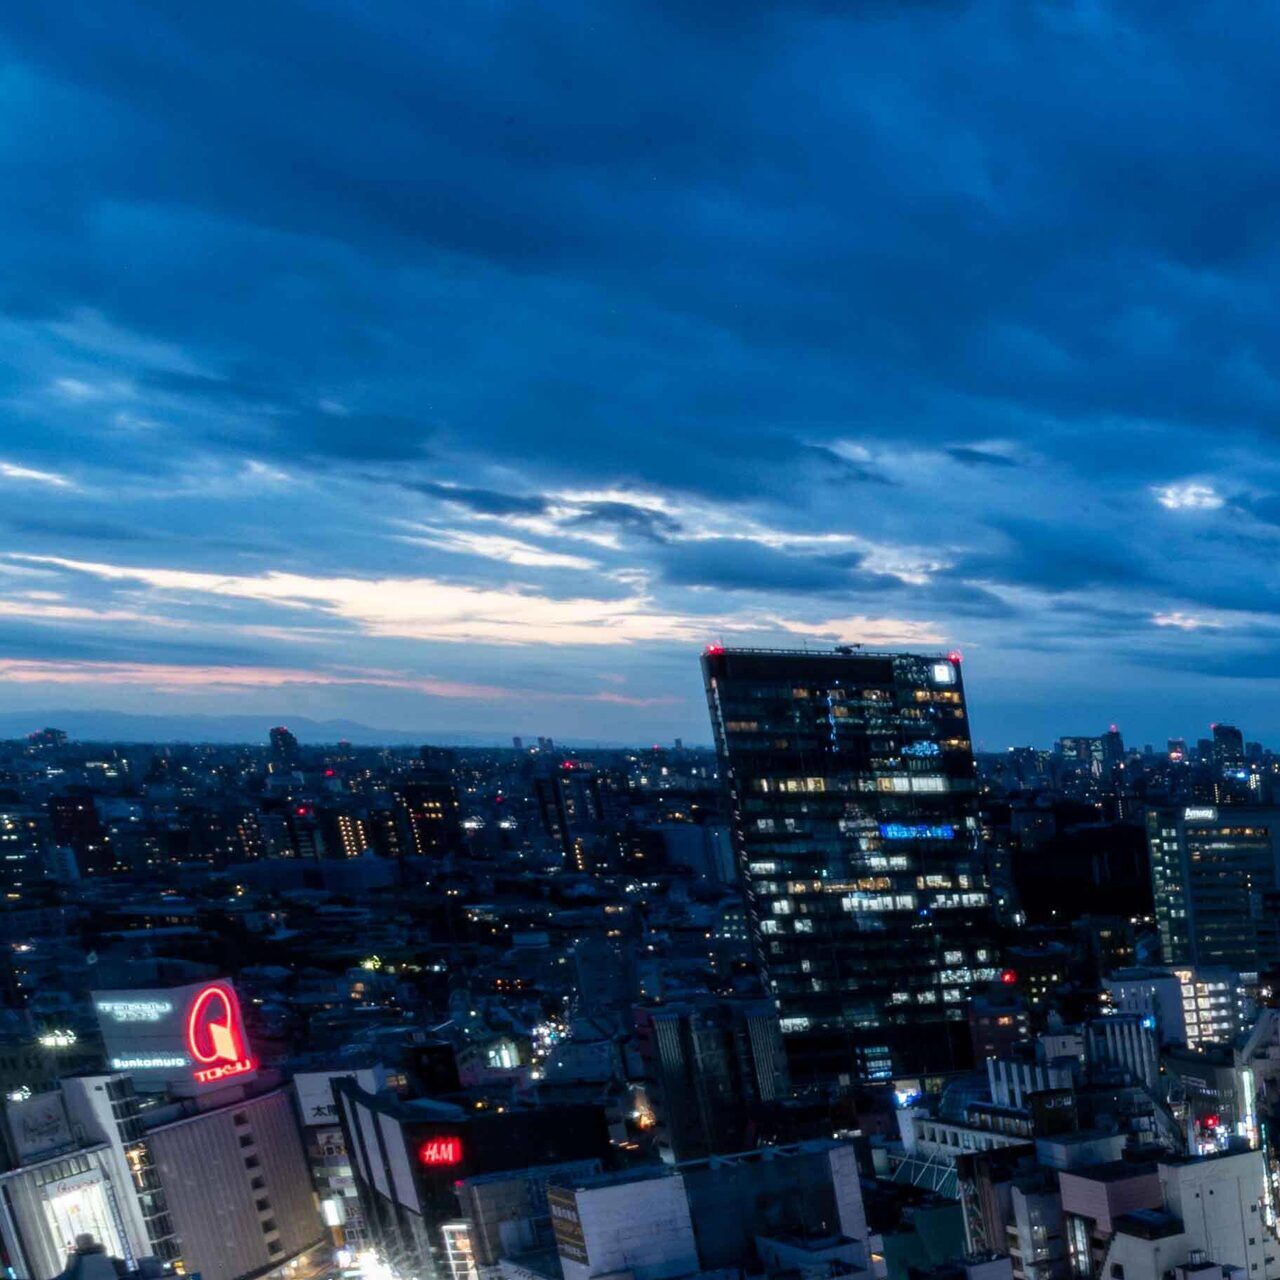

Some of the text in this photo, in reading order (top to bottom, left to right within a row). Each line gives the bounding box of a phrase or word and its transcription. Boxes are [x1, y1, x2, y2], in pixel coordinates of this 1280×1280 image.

[112, 1057, 185, 1068] Bunkamura
[195, 1059, 254, 1083] TOKYU
[423, 1139, 457, 1163] H&M
